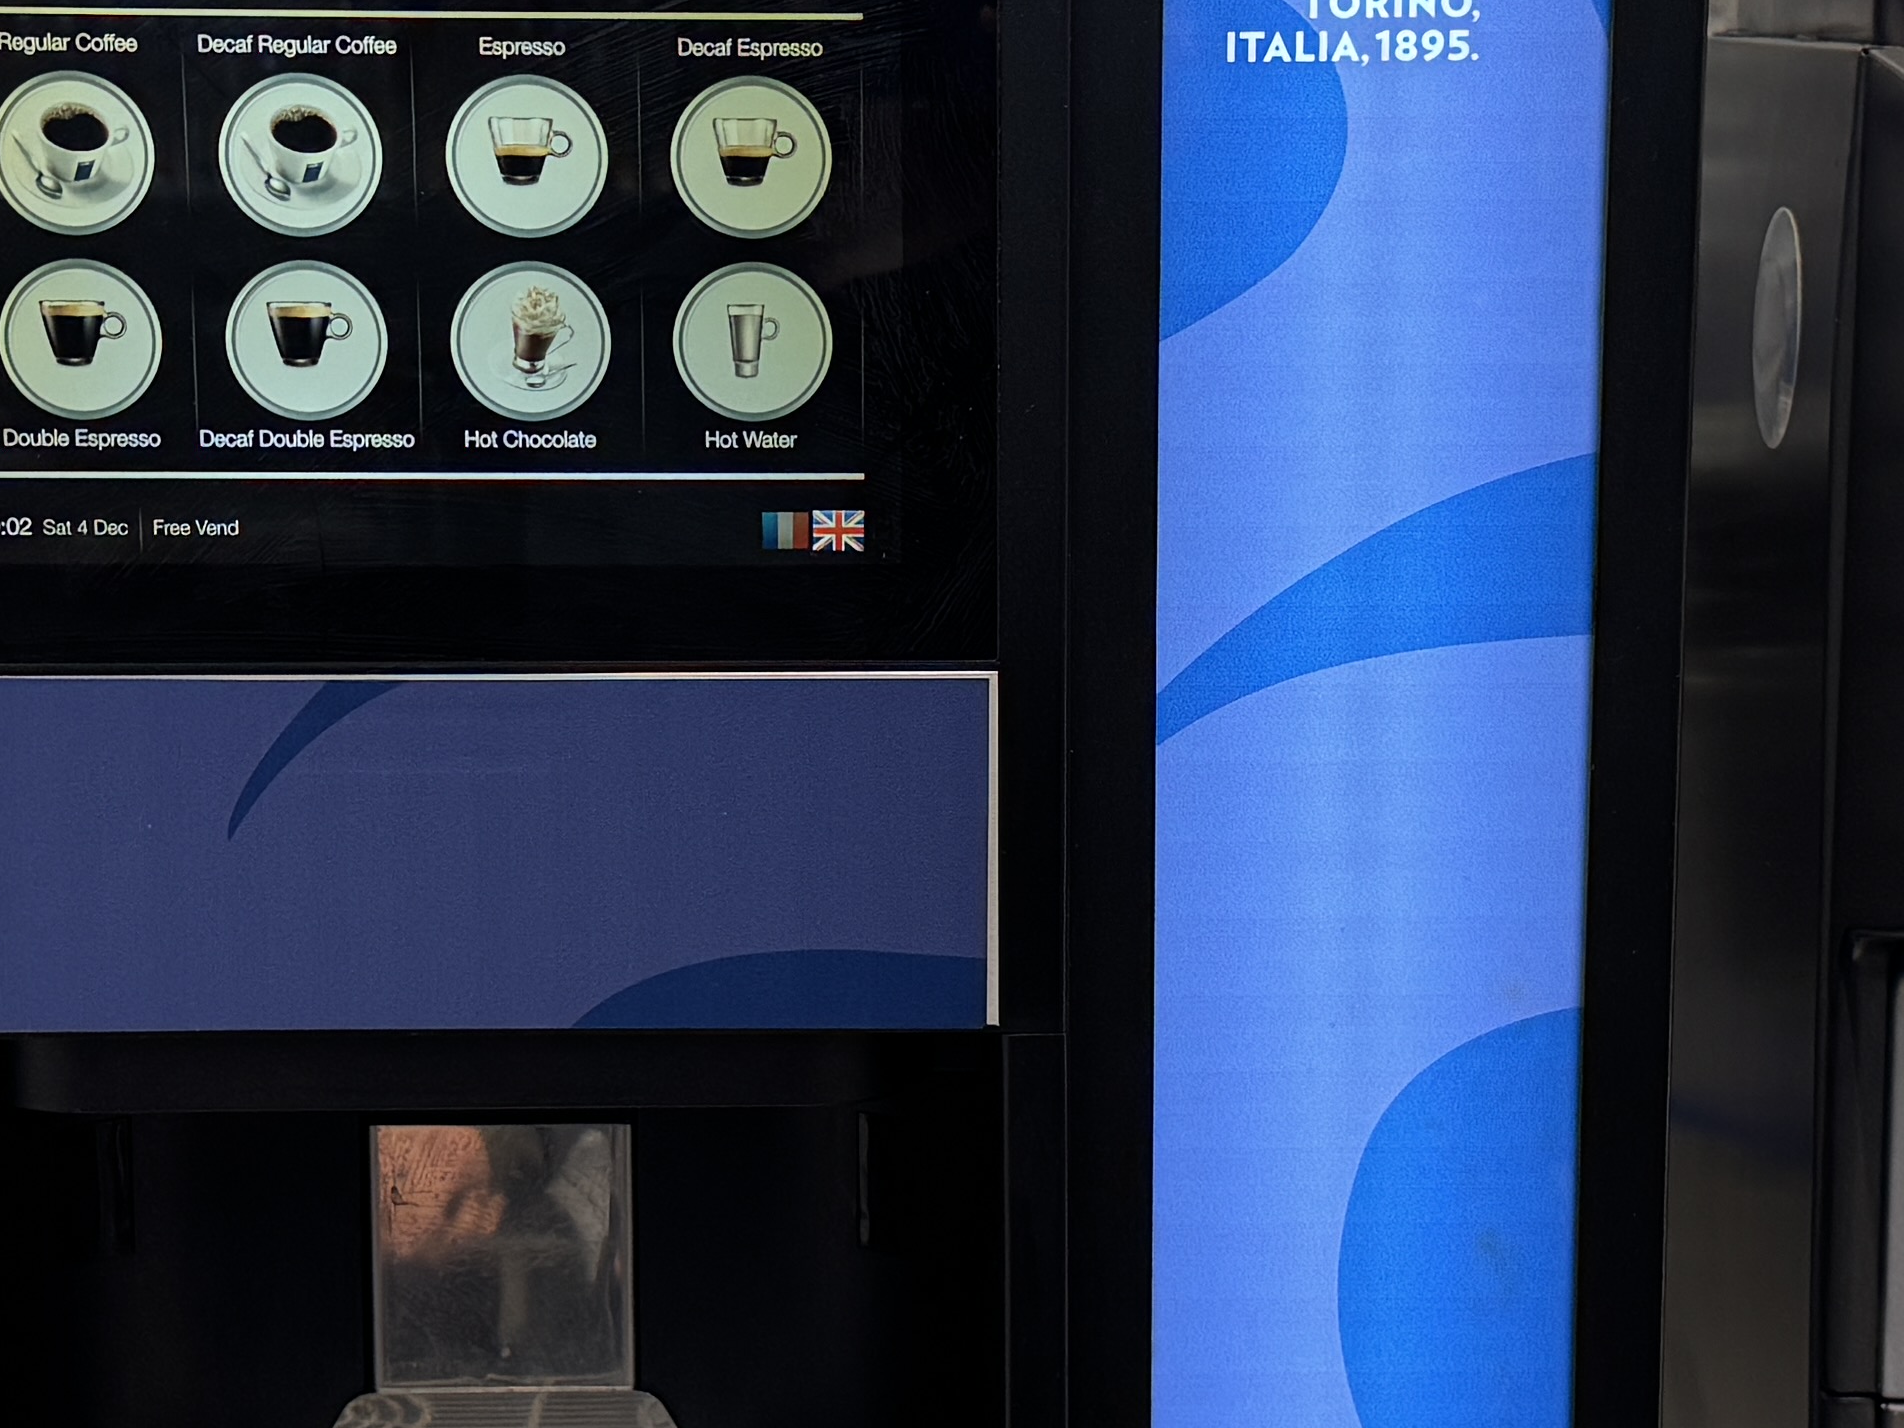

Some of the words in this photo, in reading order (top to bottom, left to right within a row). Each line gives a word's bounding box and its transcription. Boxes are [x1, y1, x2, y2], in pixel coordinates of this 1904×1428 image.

[75, 32, 138, 52] Coffee
[197, 33, 253, 53] Decaf
[258, 34, 331, 58] Regular
[335, 35, 397, 55] Coffee
[479, 37, 566, 59] Espresso
[677, 38, 732, 57] Decaf
[737, 38, 824, 60] Espresso
[1226, 30, 1370, 67] ITALIA,
[1374, 29, 1480, 62] 1895.
[3, 428, 70, 448] Double
[75, 429, 161, 449] Espresso
[200, 429, 254, 448] Decaf
[259, 429, 324, 448] Double
[330, 430, 416, 451] Espresso
[465, 430, 498, 448] Hot
[503, 430, 597, 449] Chocolate
[705, 431, 739, 449] Hot
[742, 431, 797, 450] Water
[43, 518, 72, 536] Sat
[77, 519, 88, 535] 4
[94, 518, 128, 536] Dec
[153, 519, 190, 536] Free
[195, 519, 239, 536] Vend
